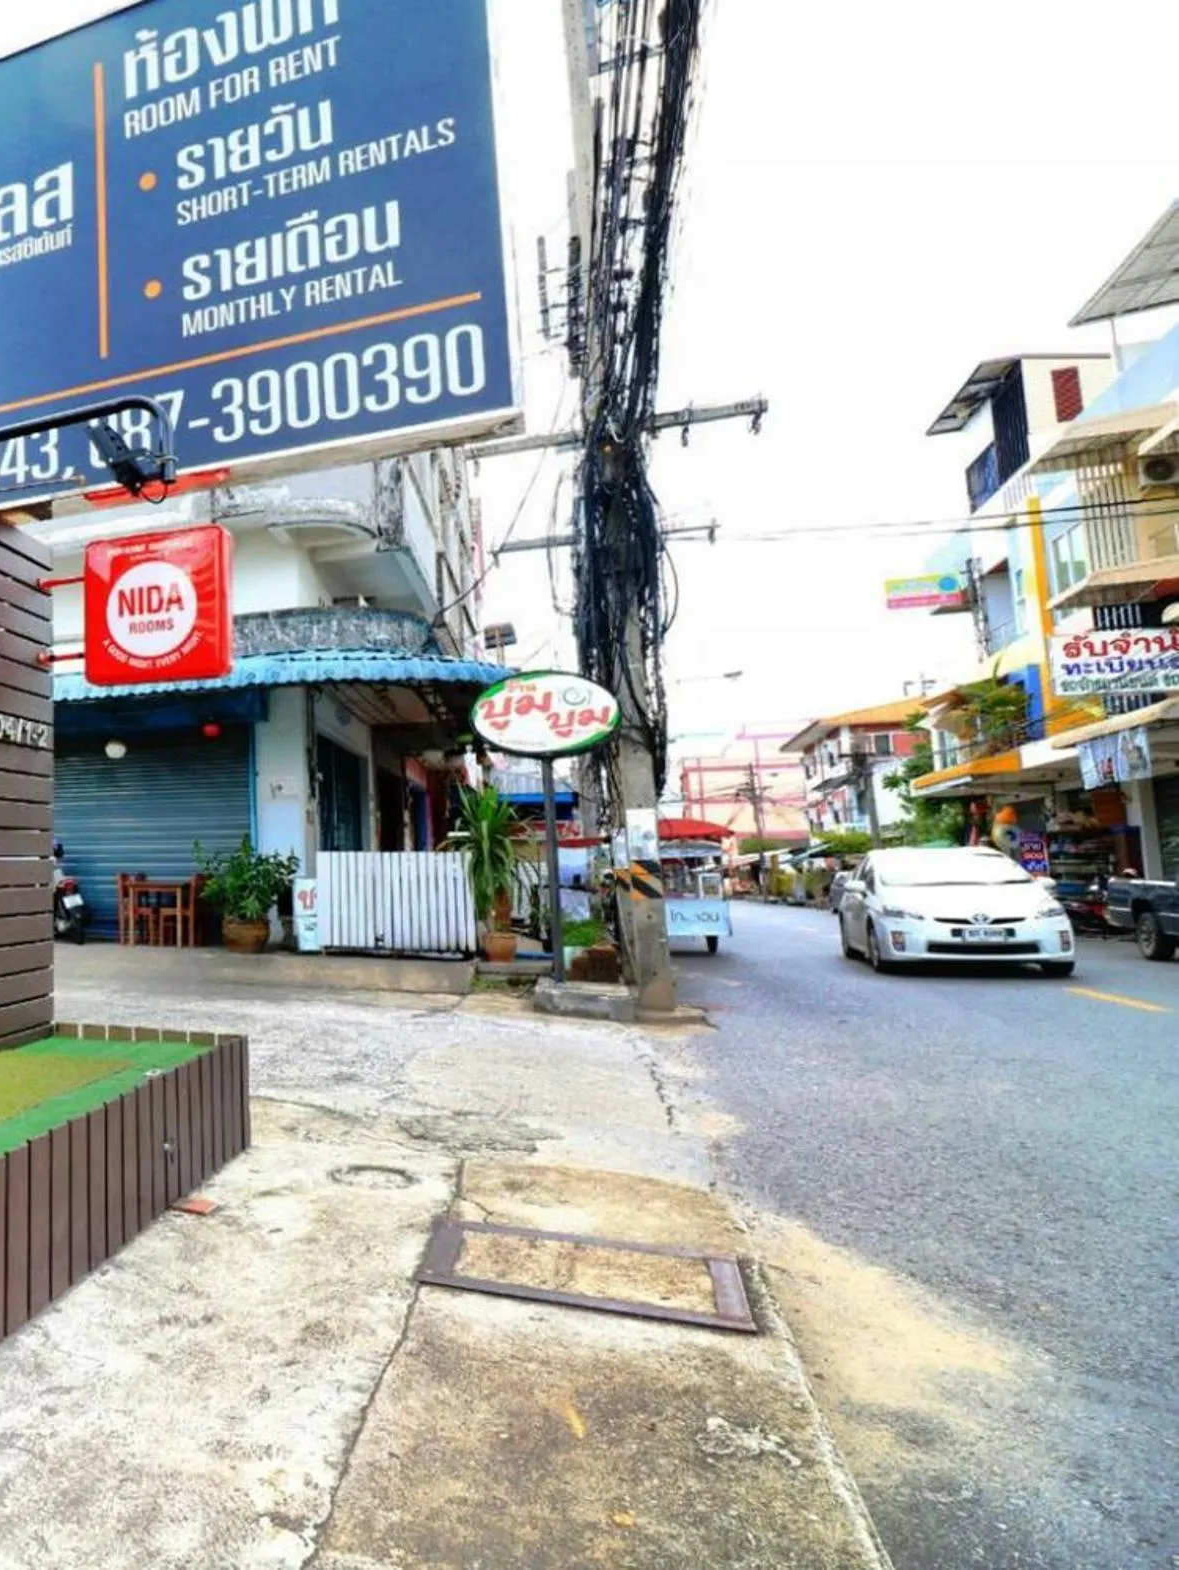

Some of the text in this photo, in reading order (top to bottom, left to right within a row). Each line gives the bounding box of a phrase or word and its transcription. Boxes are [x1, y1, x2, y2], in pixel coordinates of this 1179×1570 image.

[124, 0, 339, 99] ห้องพก
[124, 35, 341, 139] ROOM FOR RENT
[176, 100, 333, 190] รายวัน
[177, 117, 456, 226] SHORT-TERM RENTALS
[182, 200, 402, 301] รายเดือน
[182, 260, 403, 338] MONTHLY RENTAL
[118, 581, 184, 618] NIDA
[129, 618, 175, 635] ROOMS
[1063, 625, 1179, 658] รับจำน
[479, 691, 611, 738] บูม บูม
